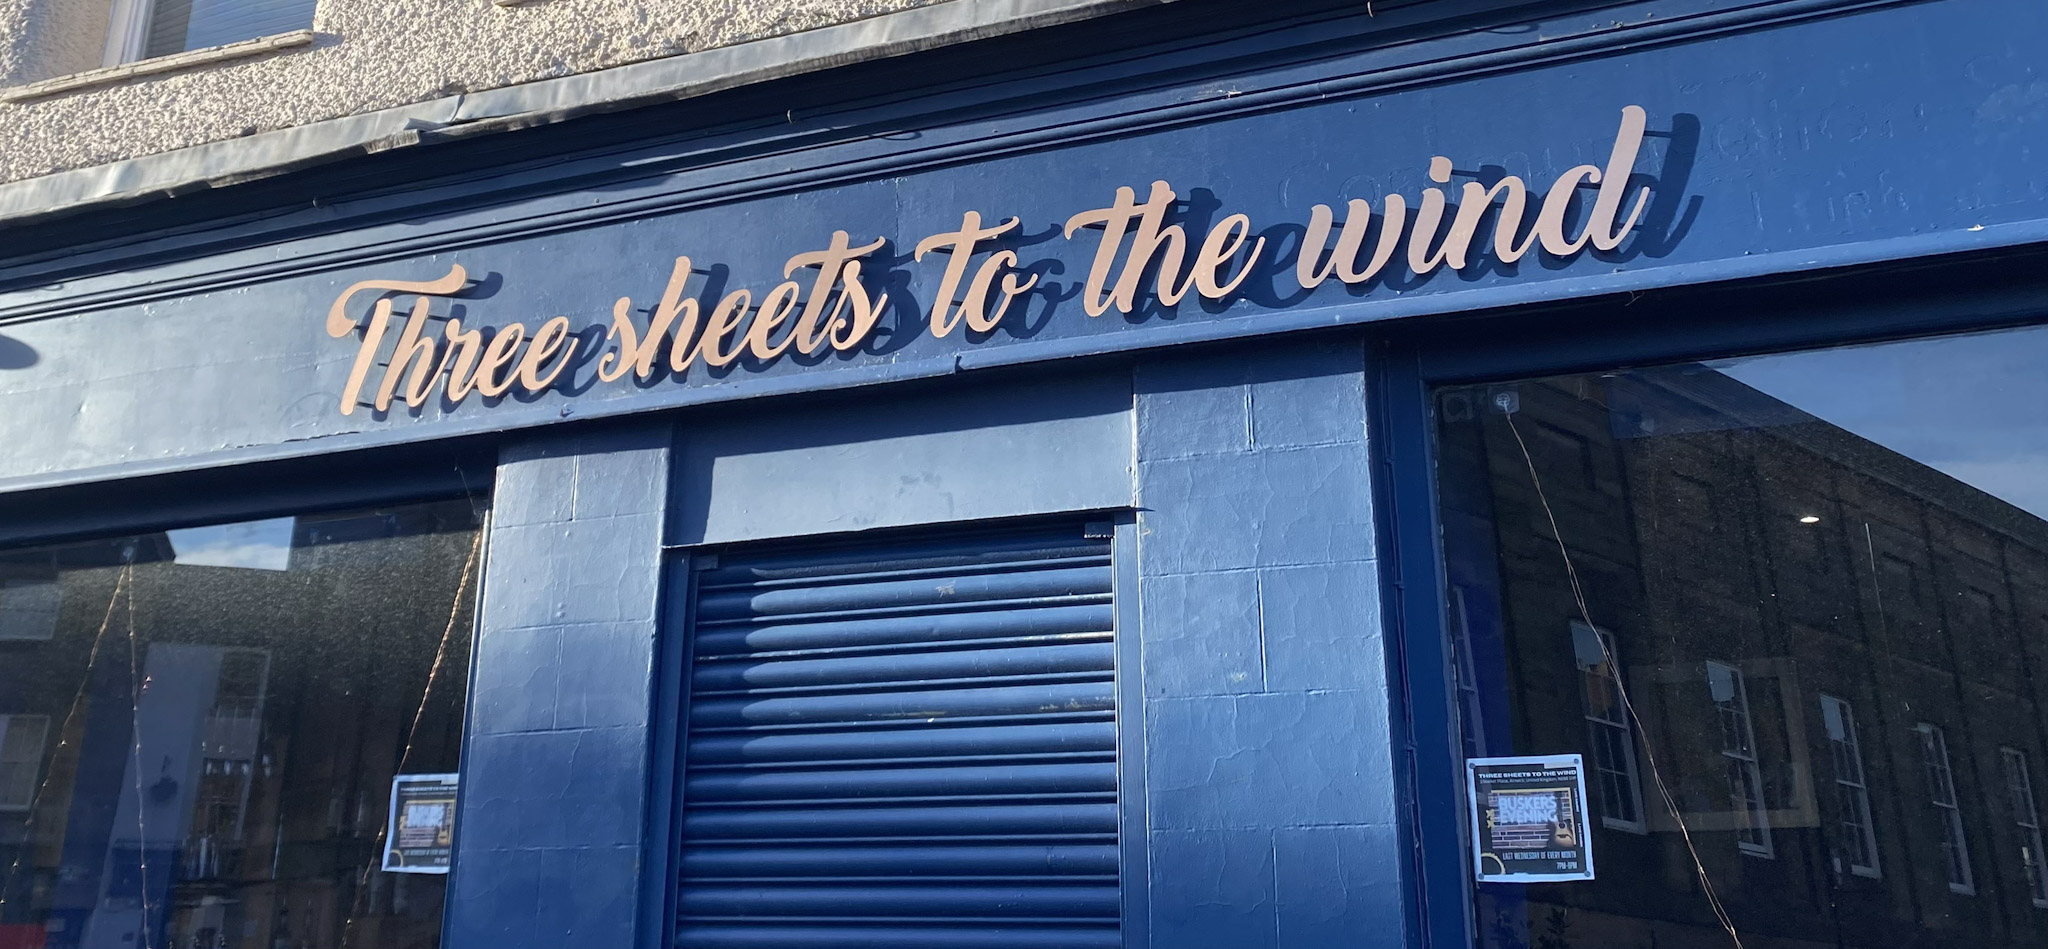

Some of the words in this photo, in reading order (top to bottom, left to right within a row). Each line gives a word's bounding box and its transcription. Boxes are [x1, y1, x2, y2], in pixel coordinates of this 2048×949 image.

[327, 264, 578, 415] Three
[598, 231, 887, 382] sheets
[915, 212, 1037, 337] to
[1064, 180, 1265, 317] the
[1297, 105, 1649, 289] wind
[1498, 795, 1557, 810] BUSKERS
[1499, 809, 1557, 823] EVENING
[1514, 852, 1539, 860] WEDNESDAY
[1540, 851, 1546, 859] OF
[1547, 851, 1560, 859] EVERY
[1561, 850, 1576, 858] MONTH
